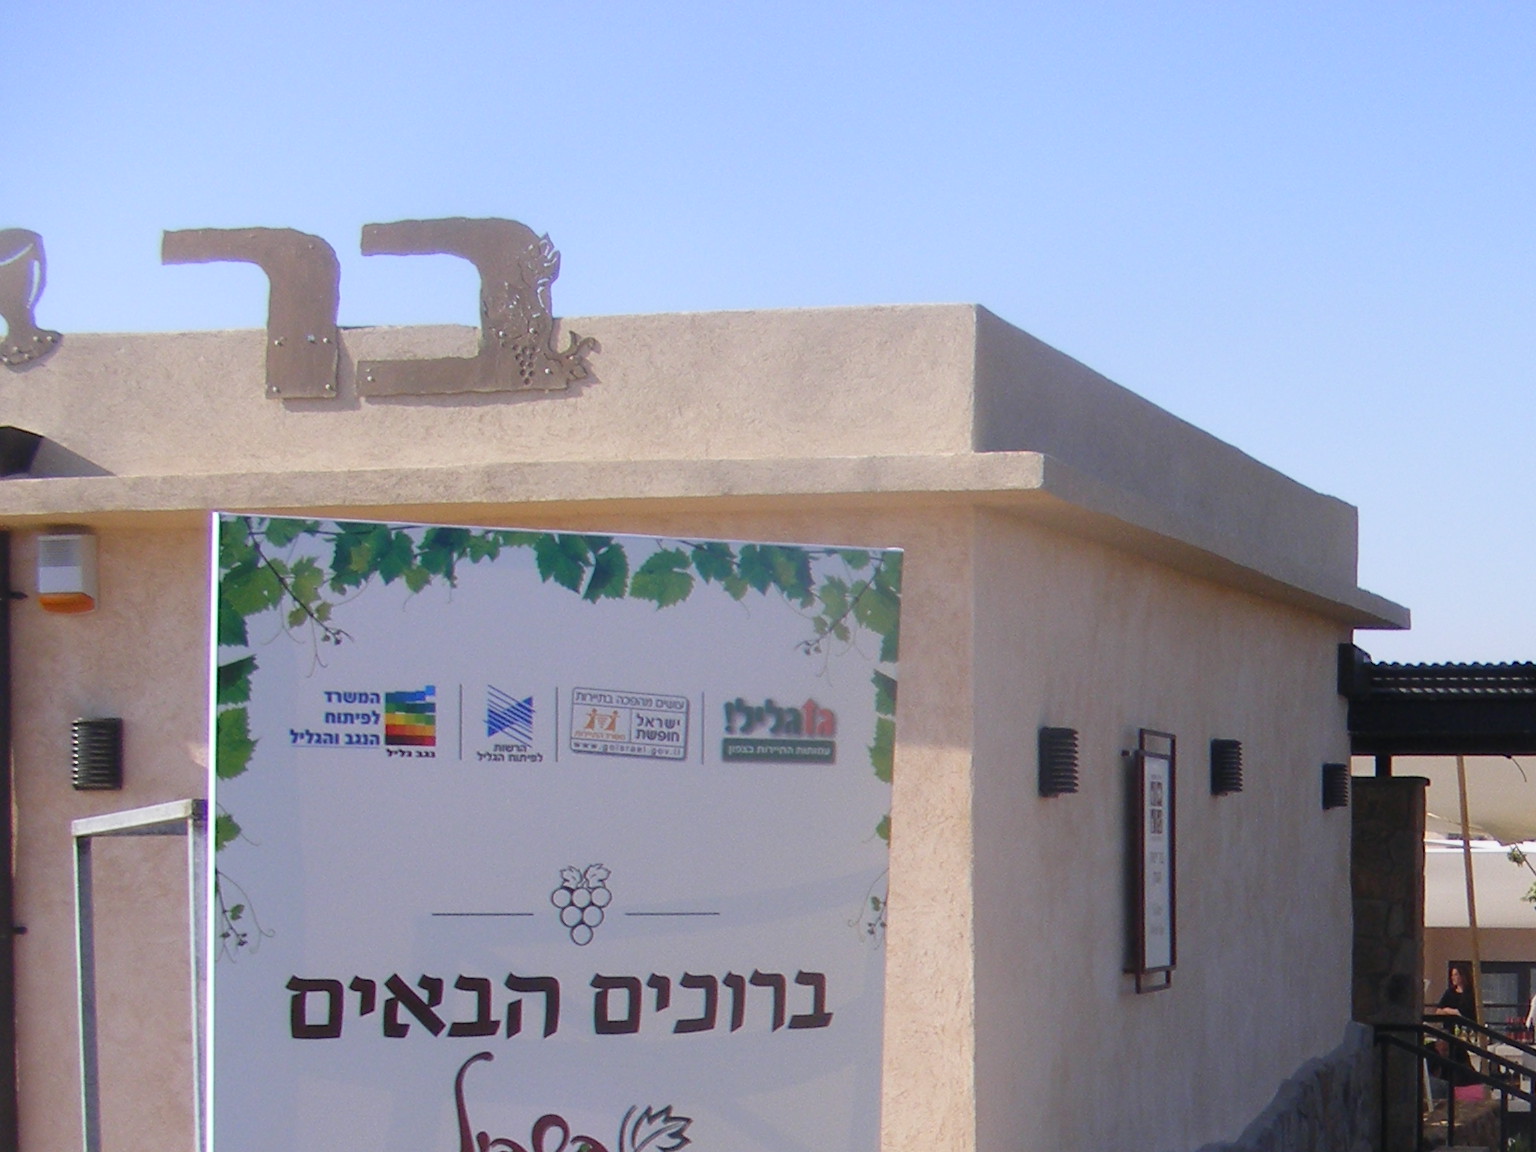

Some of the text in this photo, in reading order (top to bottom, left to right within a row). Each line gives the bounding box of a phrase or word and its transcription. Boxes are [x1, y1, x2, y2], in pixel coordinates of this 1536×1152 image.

[324, 690, 381, 704] המשרד
[616, 695, 653, 707] מהפכה
[325, 710, 381, 725] לפיתוח
[635, 712, 681, 729] ישראל
[289, 729, 380, 746] הנגב והגליל
[416, 750, 436, 758] נגב
[476, 751, 543, 763] לפיתוח הגליל
[285, 969, 834, 1040] ברוכים הבאים
